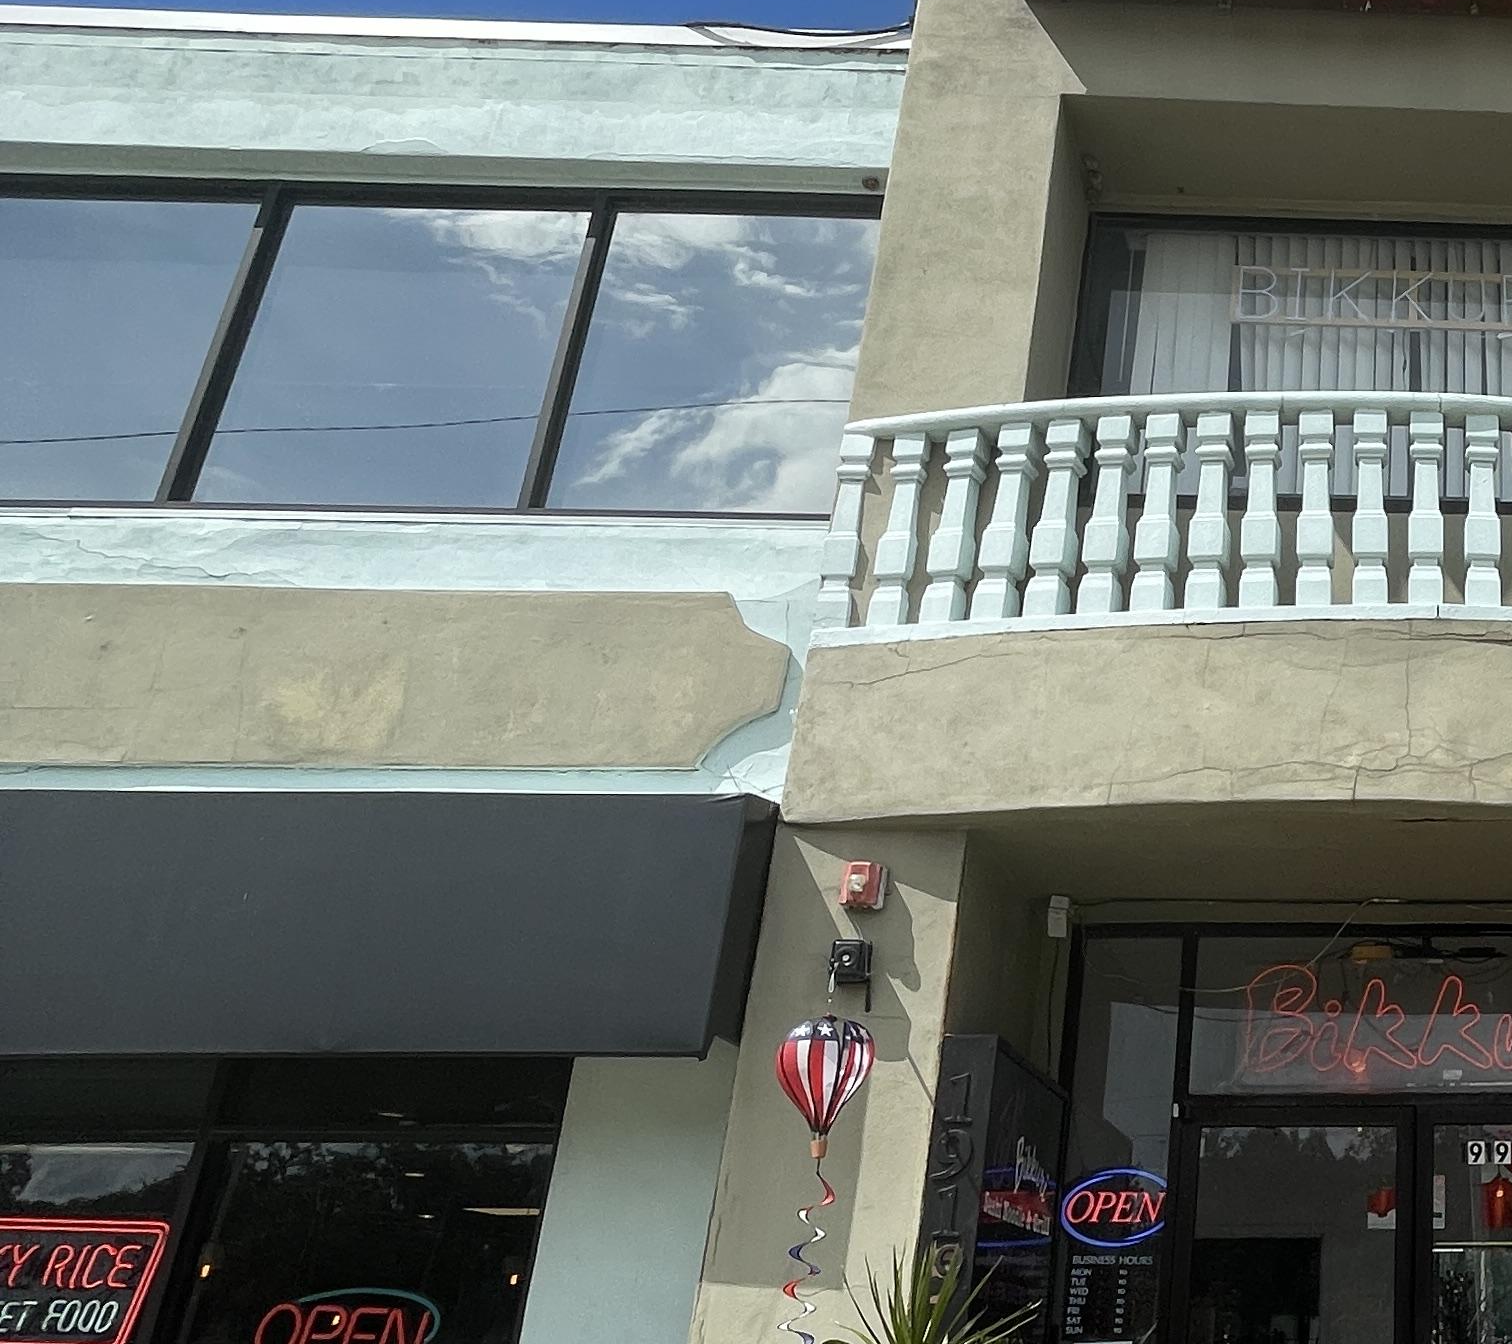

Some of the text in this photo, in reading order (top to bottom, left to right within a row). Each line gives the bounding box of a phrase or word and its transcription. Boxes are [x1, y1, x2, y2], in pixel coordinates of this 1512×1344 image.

[1066, 1190, 1167, 1224] OPEN
[1072, 1255, 1153, 1265] BUSINESS HOURS
[41, 1243, 143, 1289] RICE
[1071, 1268, 1092, 1276] MON
[1069, 1287, 1089, 1295] WED
[0, 1299, 119, 1333] ET FOOD
[1066, 1316, 1082, 1324] SAT
[1065, 1326, 1083, 1334] SUN
